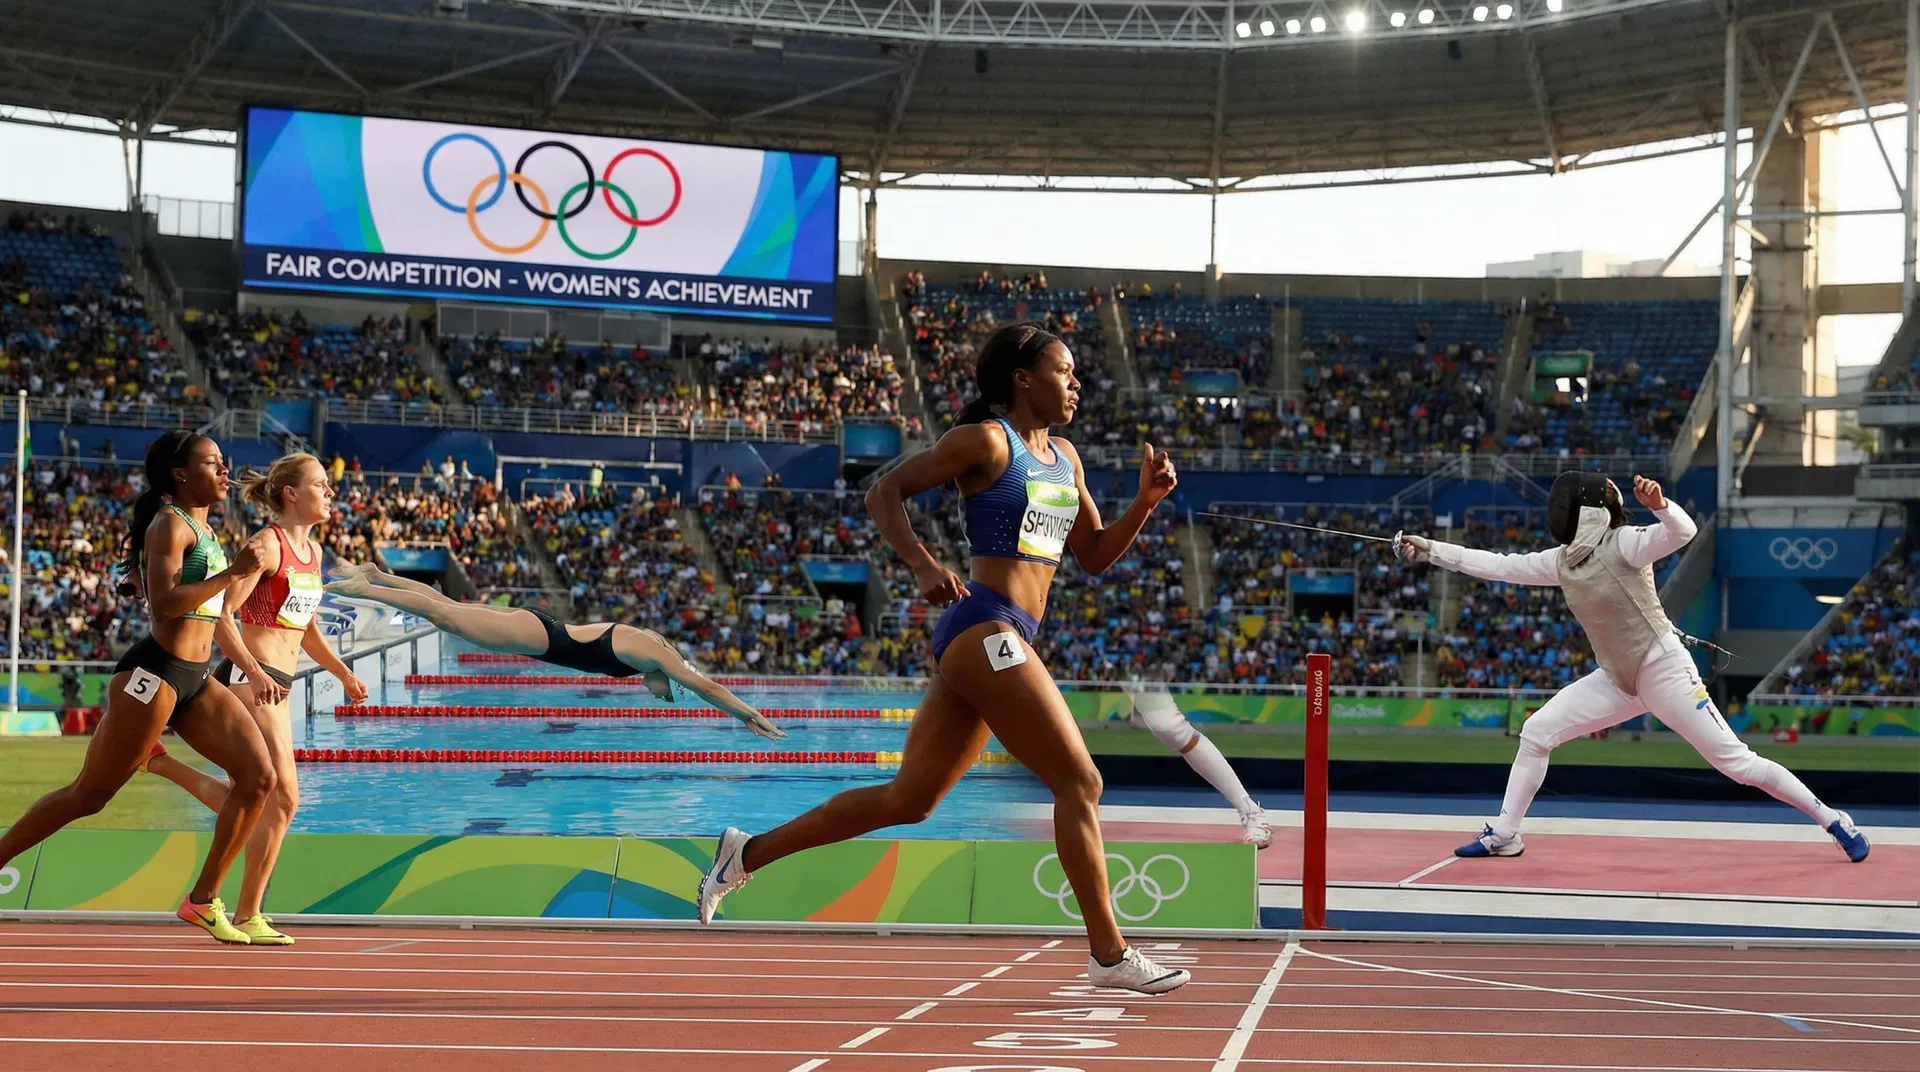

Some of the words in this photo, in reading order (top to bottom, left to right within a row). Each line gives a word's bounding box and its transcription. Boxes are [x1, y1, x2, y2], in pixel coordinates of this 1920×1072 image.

[266, 252, 321, 278] FAIR
[327, 257, 501, 289] COMPETITION
[524, 270, 641, 299] WOMEN'S
[645, 279, 813, 309] ACHIEVEMENT
[997, 639, 1014, 659] 4
[133, 676, 151, 695] 5
[1012, 1007, 1149, 1021] 4
[972, 1032, 1119, 1050] 5
